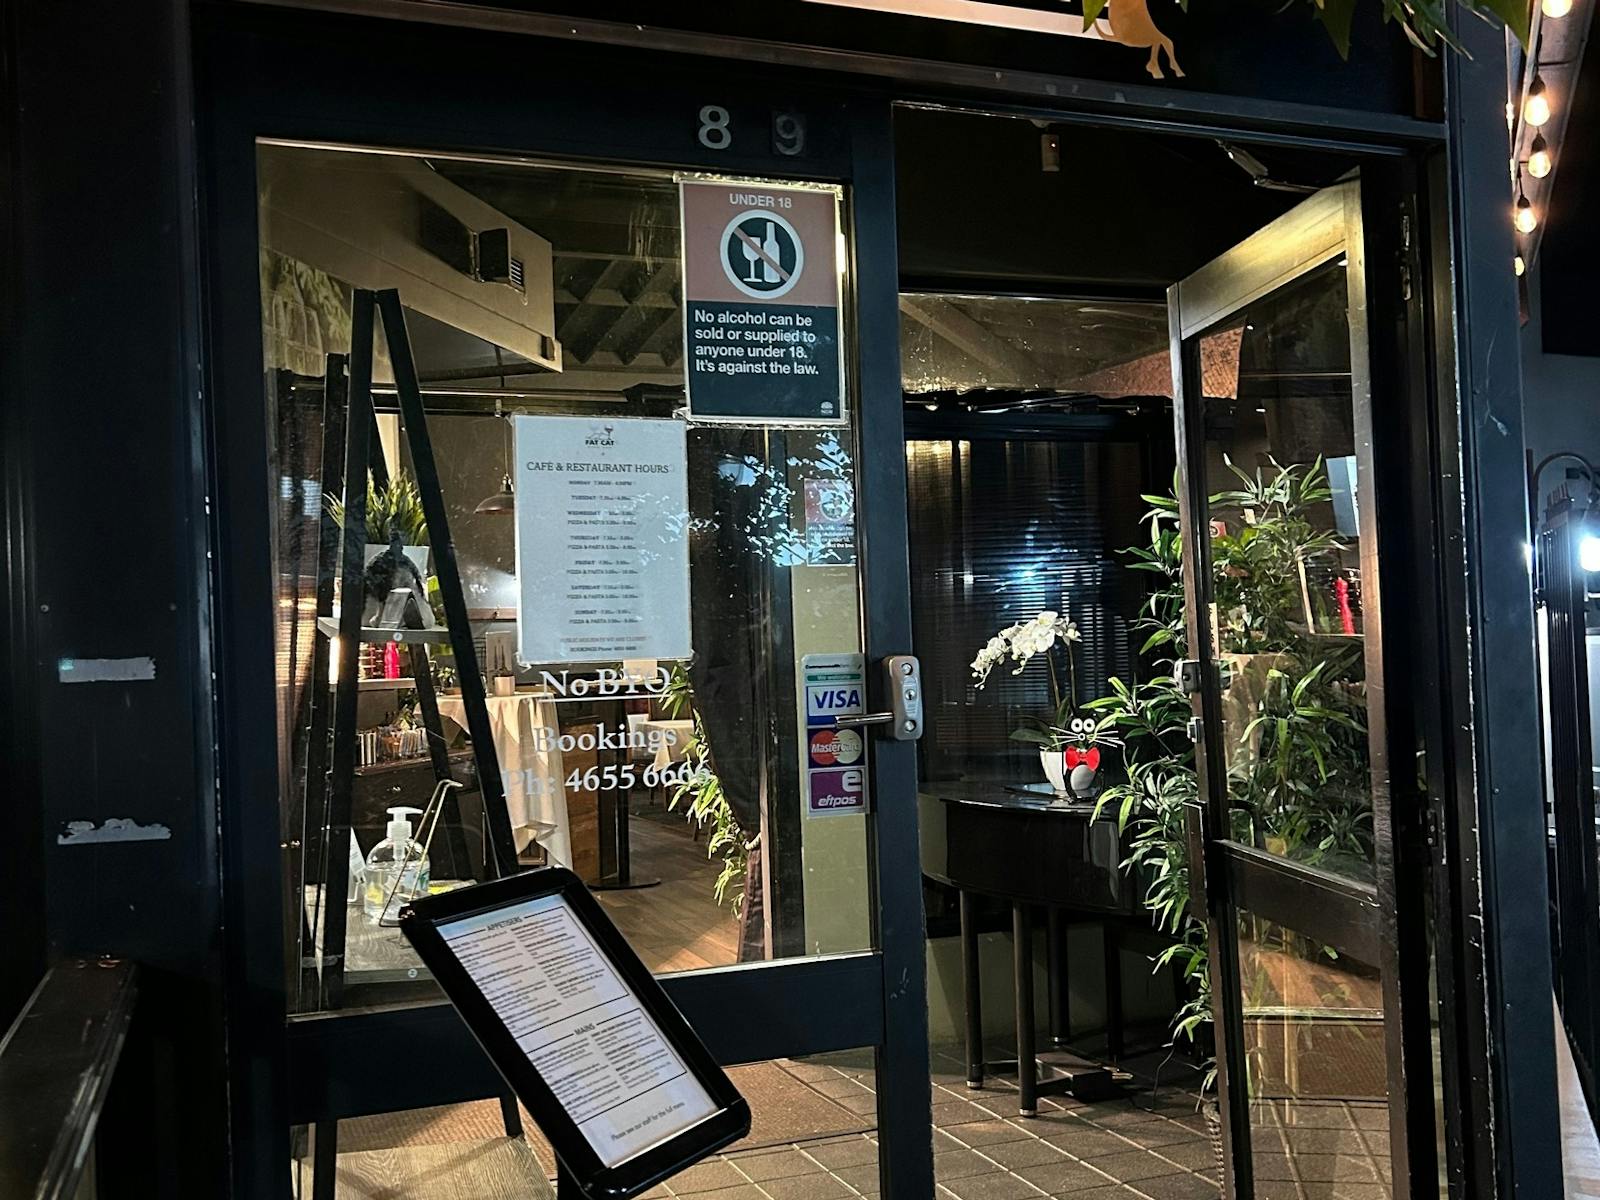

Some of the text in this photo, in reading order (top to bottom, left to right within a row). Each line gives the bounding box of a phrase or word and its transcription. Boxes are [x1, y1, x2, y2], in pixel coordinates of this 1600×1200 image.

[698, 104, 732, 150] 8
[775, 114, 804, 156] 9
[729, 193, 792, 209] UNDER 18
[695, 310, 812, 327] No alcohol can be
[695, 326, 815, 345] sold or supplied to
[695, 345, 808, 359] anyone under 18.
[696, 360, 819, 377] It's against the law.
[556, 463, 564, 471] &
[566, 463, 632, 473] RESTAURANT
[635, 464, 669, 474] HOURS
[540, 669, 589, 697] No
[814, 689, 861, 709] VISA
[534, 722, 678, 755] Bookings
[811, 741, 861, 754] MasterCard
[564, 763, 636, 793] 4655
[818, 794, 857, 808] eftpos
[487, 917, 522, 932] APPETISERS
[574, 1023, 596, 1036] MAINS
